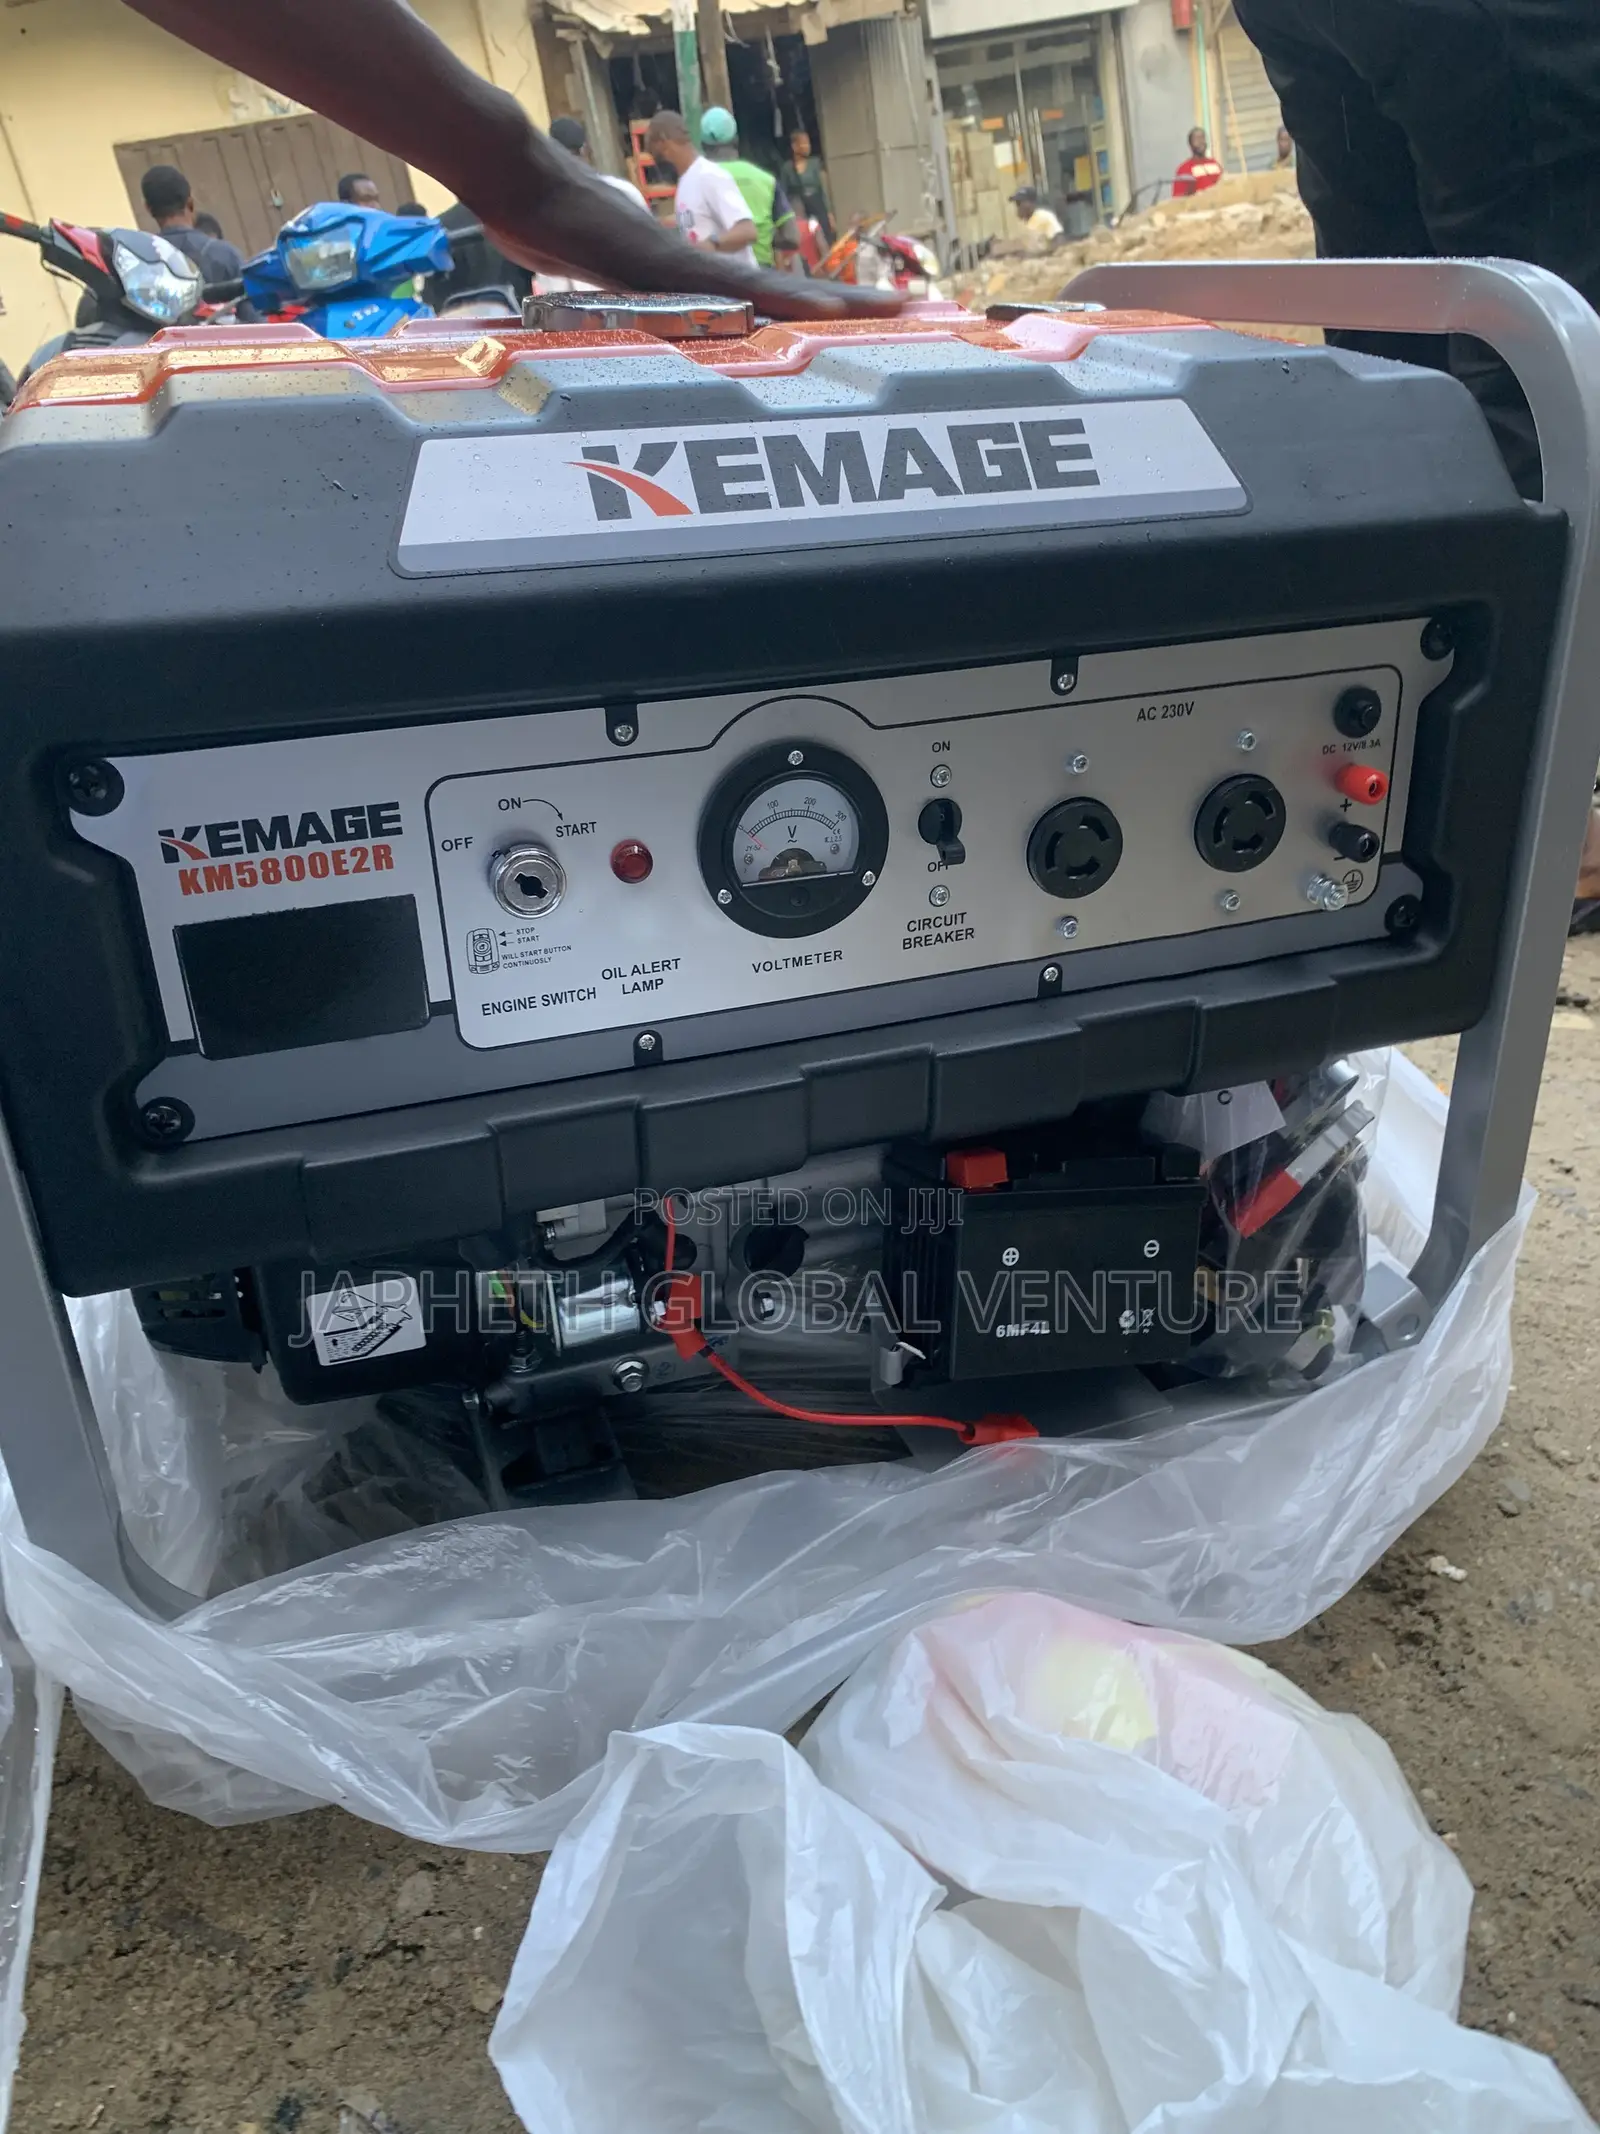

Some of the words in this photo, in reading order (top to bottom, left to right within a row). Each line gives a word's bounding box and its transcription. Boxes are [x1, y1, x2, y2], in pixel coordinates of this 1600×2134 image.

[561, 418, 1100, 521] KEMAGE
[1136, 706, 1157, 722] AC
[1161, 701, 1195, 719] 230V
[931, 741, 951, 753] ON
[1322, 744, 1336, 755] DC
[497, 796, 522, 812] ON
[767, 799, 779, 810] 100
[804, 796, 817, 806] 200
[834, 810, 847, 822] 300
[158, 801, 403, 863] KEMAGE
[555, 821, 598, 838] START
[441, 836, 474, 852] OFF
[178, 843, 395, 896] KM5800E2R
[906, 912, 967, 932] CIRCUIT
[516, 927, 535, 935] STOP
[517, 935, 540, 944] START
[902, 927, 975, 950] BREAKER
[501, 951, 518, 960] WILL
[520, 949, 542, 958] START
[543, 945, 572, 955] BUTTON
[503, 957, 552, 969] CONTINUOSLY
[601, 964, 627, 980] OIL
[628, 958, 681, 976] ALERT
[752, 950, 843, 973] VOLTMETER
[621, 978, 665, 995] LAMP
[481, 996, 537, 1016] ENGINE
[541, 987, 597, 1009] SWITCH
[995, 1321, 1051, 1338] 6MF4L
